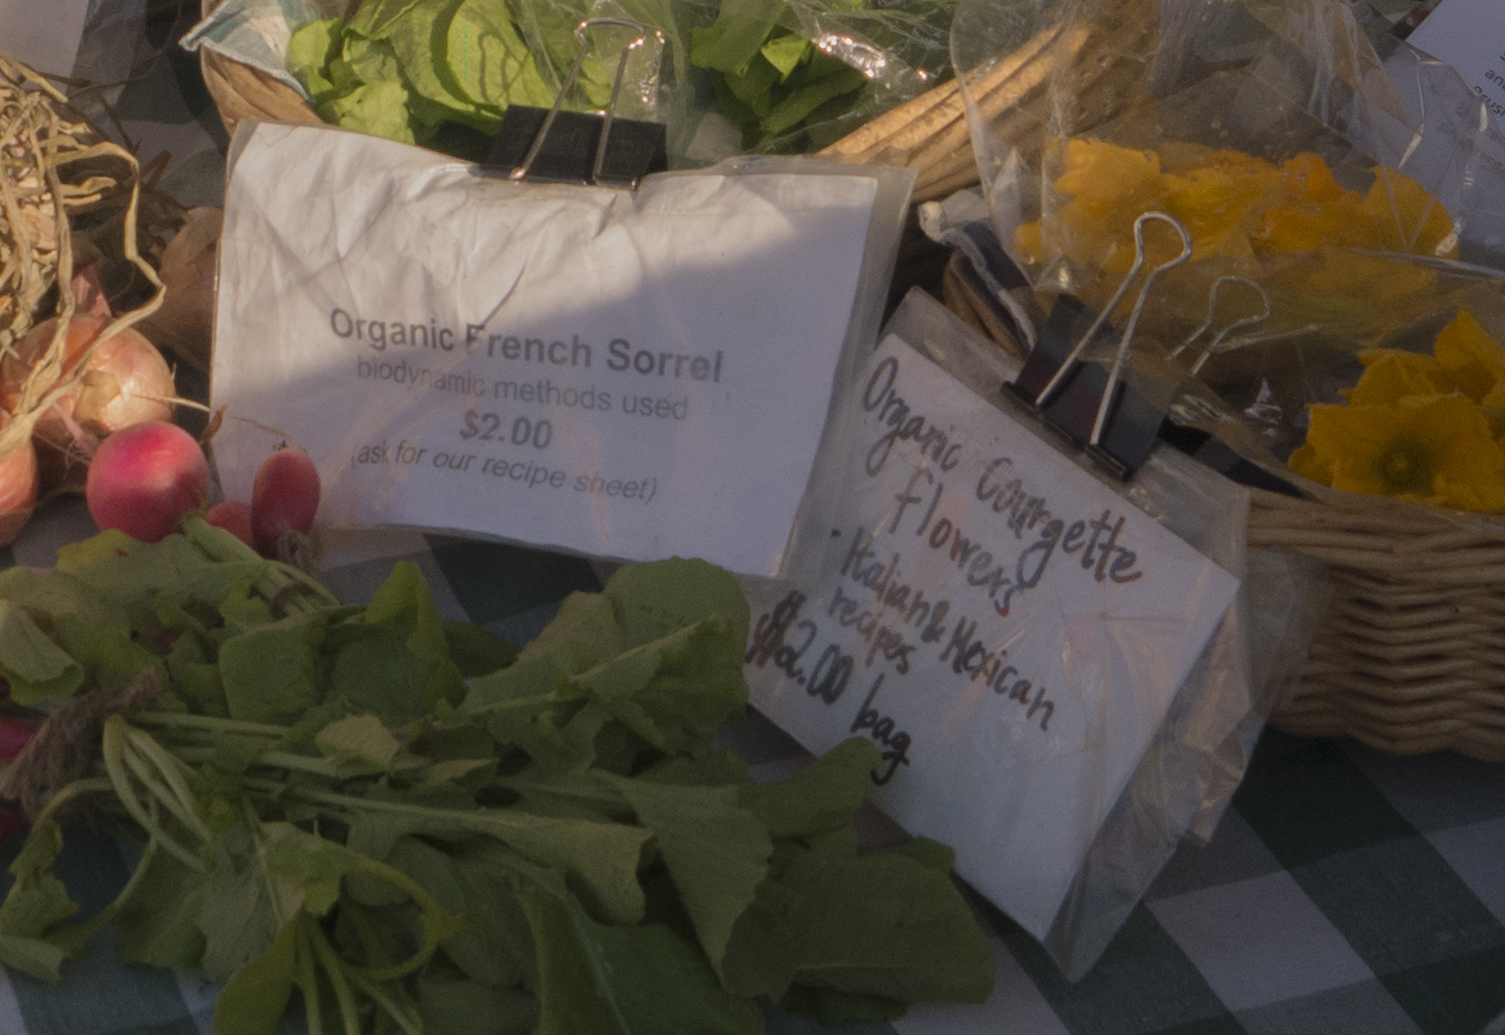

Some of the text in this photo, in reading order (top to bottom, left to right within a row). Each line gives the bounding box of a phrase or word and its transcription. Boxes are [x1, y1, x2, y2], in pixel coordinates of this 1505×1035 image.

[329, 307, 726, 384] Organic French Sorrel
[356, 355, 689, 421] biodynamic methods used
[459, 407, 554, 450] $2.00
[395, 438, 430, 466] for
[432, 450, 475, 471] our
[481, 456, 567, 491] recipe
[573, 470, 660, 505] sheet)
[863, 355, 1144, 589] Organic Courgette
[826, 586, 916, 676] recipes
[745, 590, 912, 786] $2.00 bag
